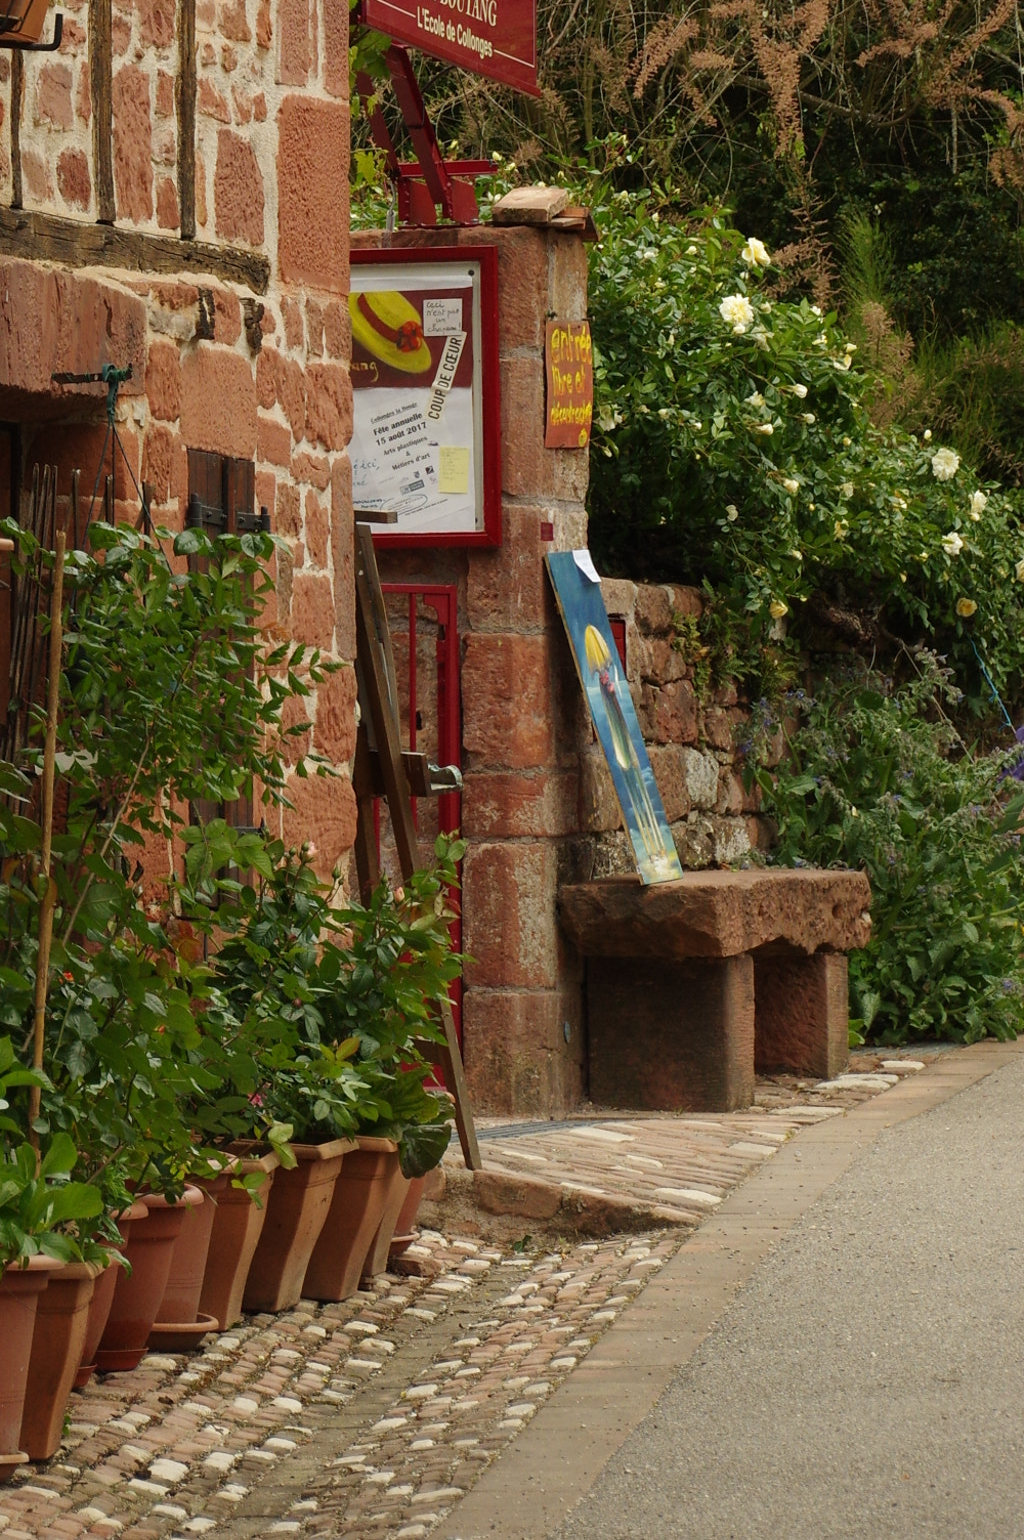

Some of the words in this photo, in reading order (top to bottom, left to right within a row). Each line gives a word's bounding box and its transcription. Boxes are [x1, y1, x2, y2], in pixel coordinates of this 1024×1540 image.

[417, 6, 445, 38] L'Ecole
[446, 19, 456, 43] de
[457, 23, 493, 60] Collonges
[428, 389, 446, 420] COUP
[437, 373, 452, 389] DE
[373, 426, 389, 436] Fête
[391, 413, 423, 430] annuelle
[376, 437, 386, 446] 15
[388, 430, 405, 442] août
[406, 421, 427, 435] 2017
[383, 448, 396, 456] Arts
[397, 436, 428, 452] plastiques
[392, 459, 415, 470] Métiers
[415, 453, 430, 462] d'art
